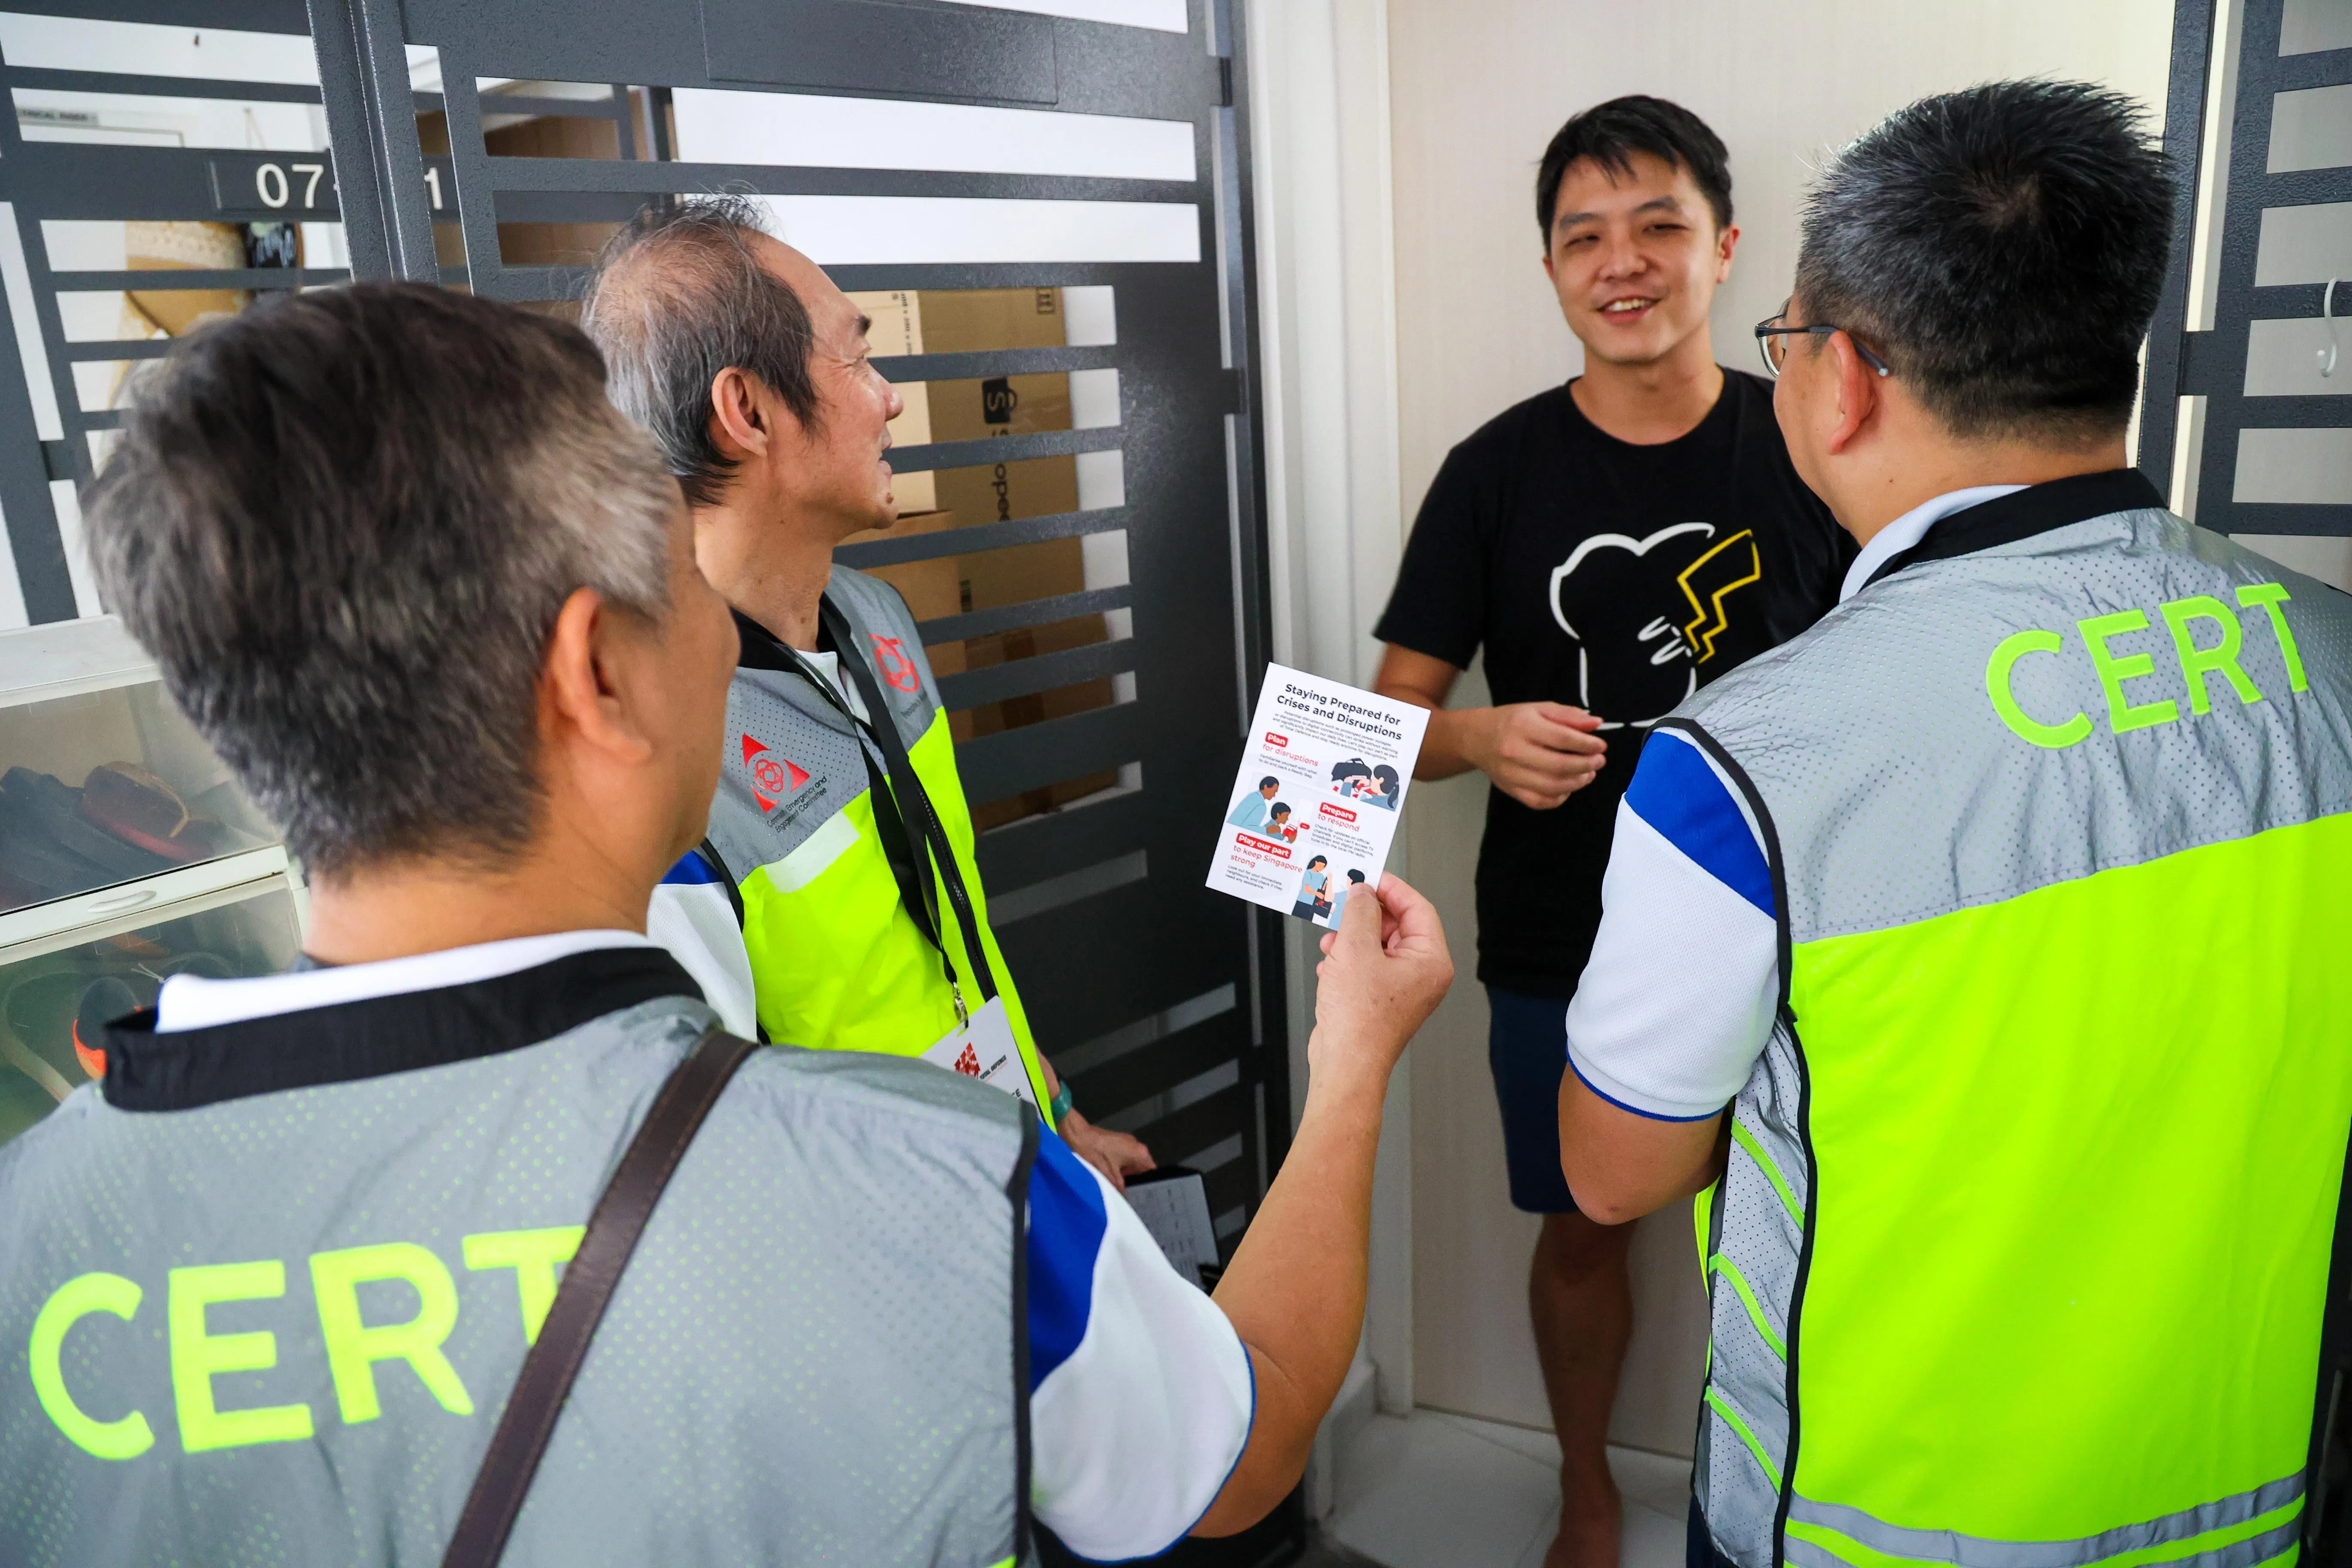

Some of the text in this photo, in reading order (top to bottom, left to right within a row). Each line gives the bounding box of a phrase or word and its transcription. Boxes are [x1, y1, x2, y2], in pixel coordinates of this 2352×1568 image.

[1985, 582, 2309, 749] CERT
[1285, 684, 1400, 725] Staying Prepared for
[1277, 695, 1402, 740] Crises and Disruptions
[1280, 715, 1301, 724] disruptions
[1320, 727, 1344, 738] connectivity
[1281, 720, 1304, 730] significantly
[1302, 717, 1324, 726] disruptions
[1340, 729, 1361, 737] prolonged
[1268, 734, 1286, 745] Plan
[1263, 743, 1319, 767] for disruptions
[785, 785, 816, 811] Emergency
[815, 775, 827, 788] and
[1322, 804, 1354, 820] Prepare
[1327, 817, 1360, 832] respond
[1238, 835, 1289, 857] Play our part
[1231, 855, 1256, 868] strong
[1243, 848, 1262, 860] keep
[1263, 855, 1302, 873] Singapore
[1261, 876, 1282, 885] immediate
[29, 1225, 588, 1461] CERT
